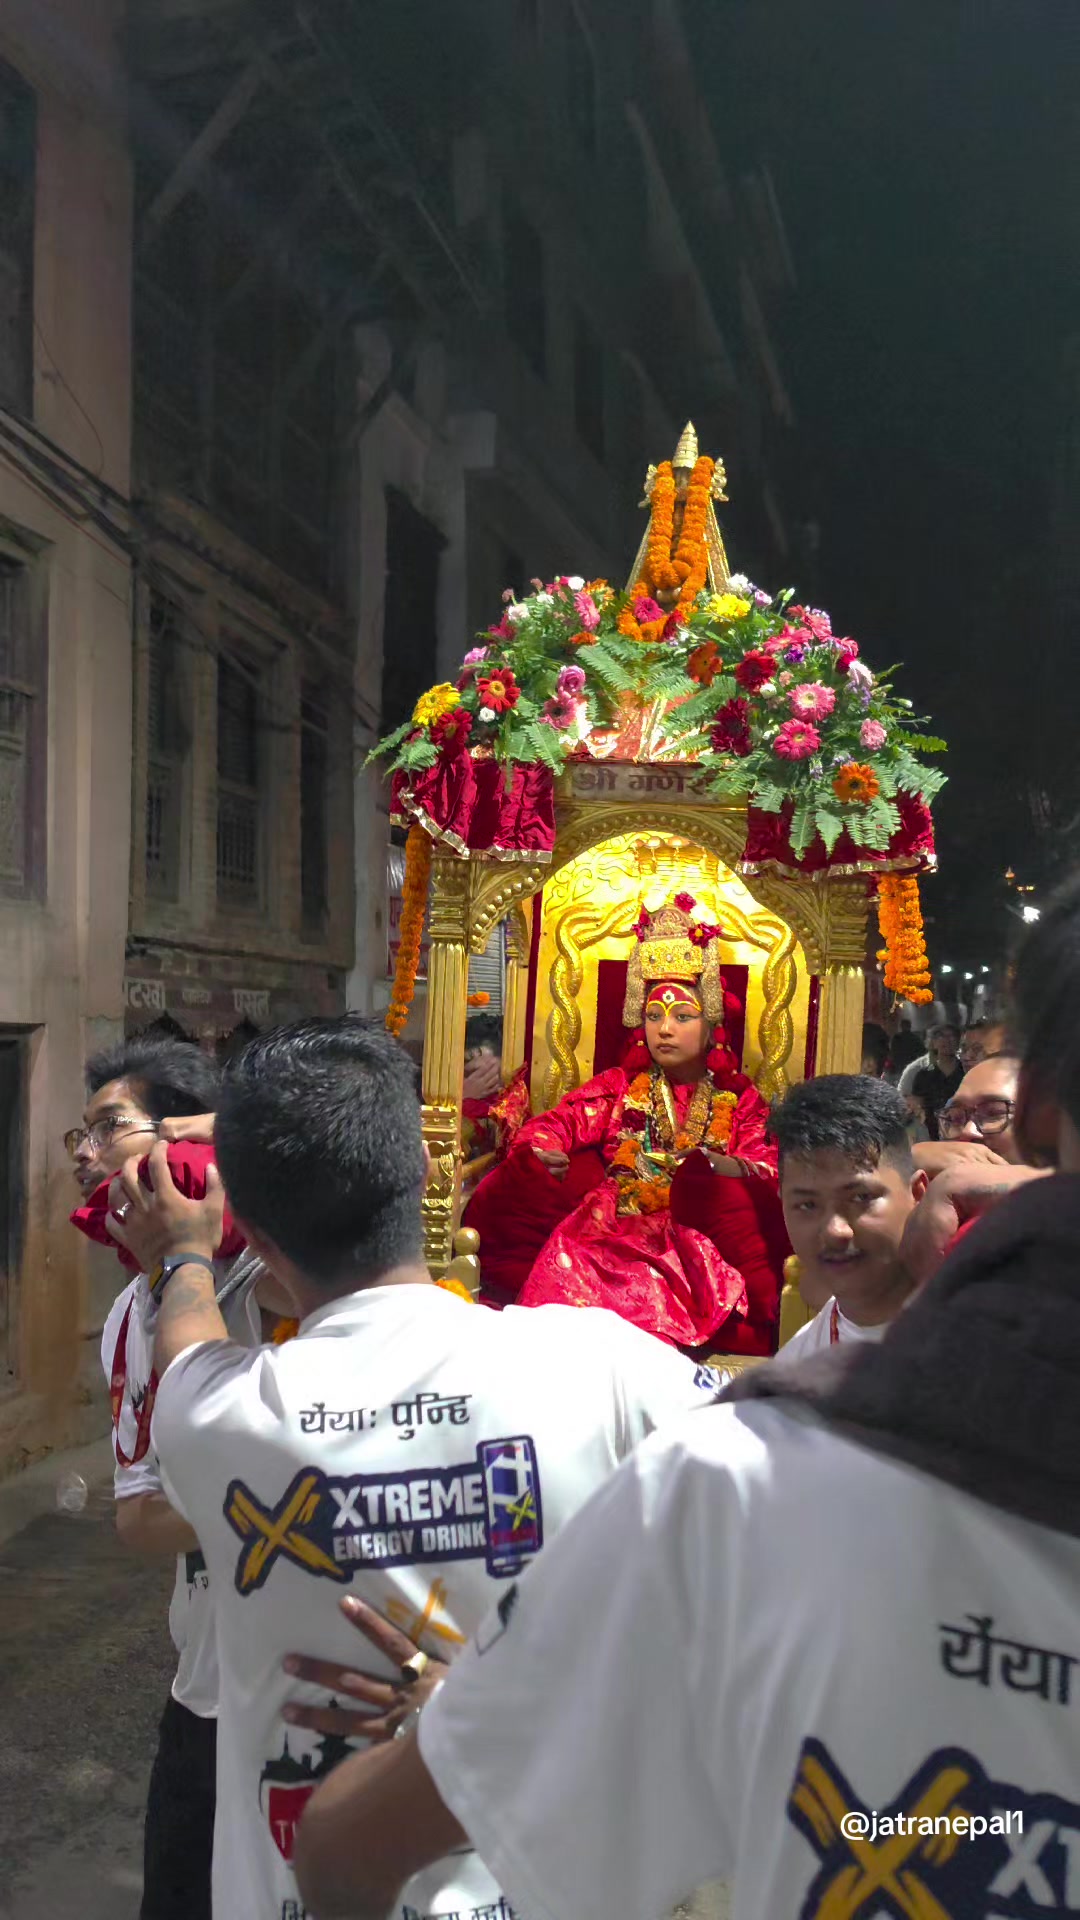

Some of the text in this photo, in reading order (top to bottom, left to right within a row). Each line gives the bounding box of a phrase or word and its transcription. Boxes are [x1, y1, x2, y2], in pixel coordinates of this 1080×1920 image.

[330, 1472, 485, 1530] XTREME
[332, 1520, 488, 1562] ENERGY DRINK
